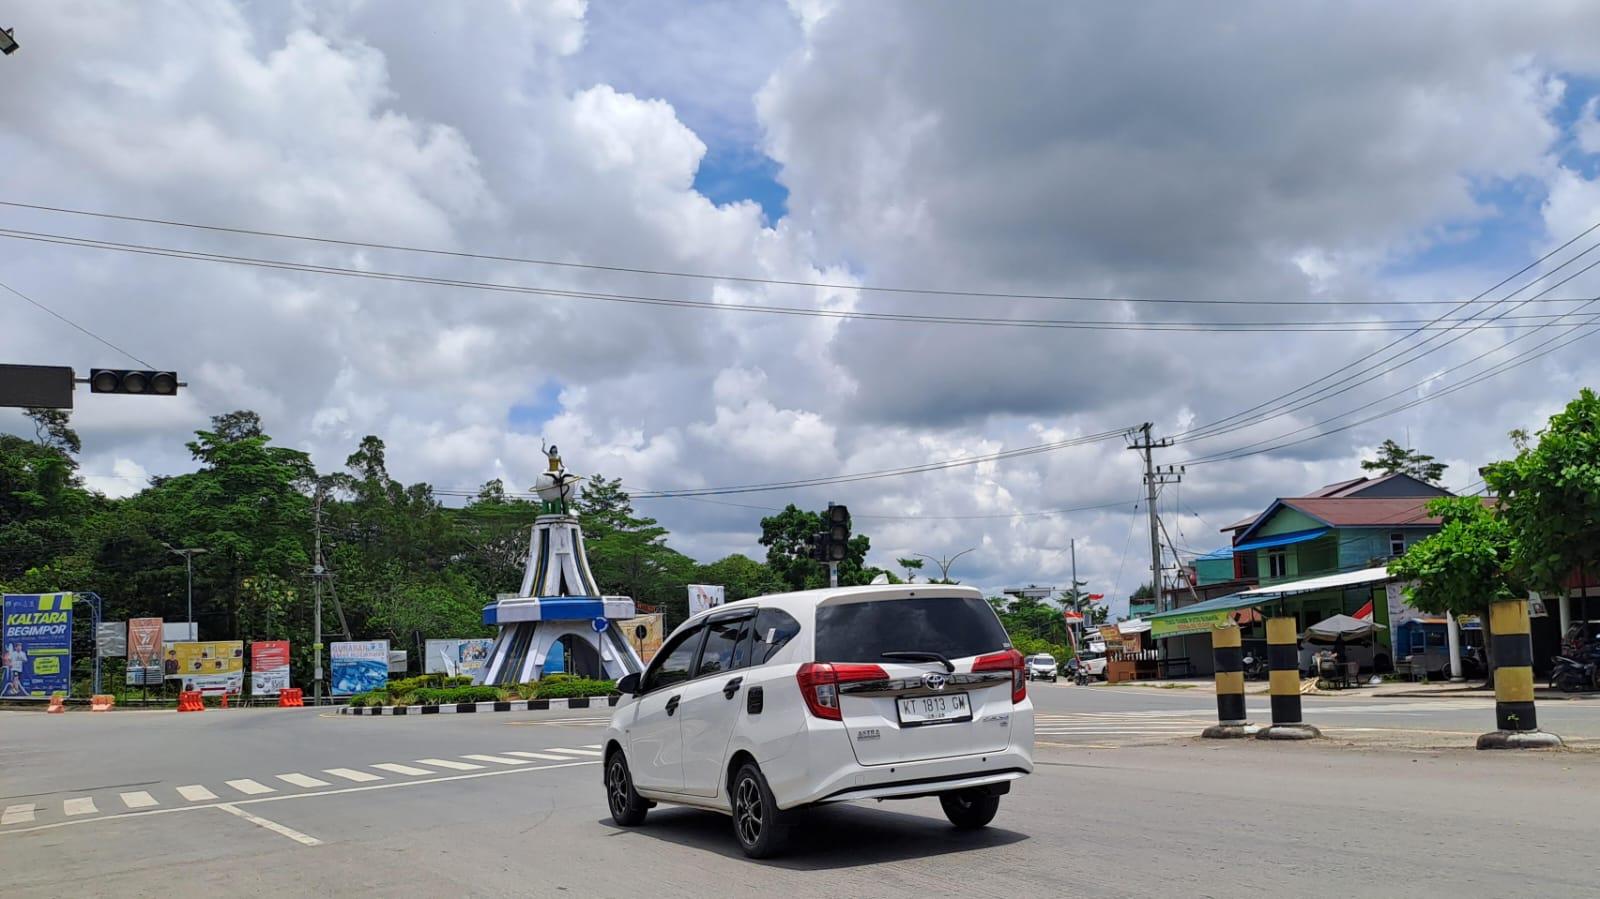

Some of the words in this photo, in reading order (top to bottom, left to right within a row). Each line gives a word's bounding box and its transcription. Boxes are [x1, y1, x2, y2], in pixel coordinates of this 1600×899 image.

[6, 612, 68, 626] KALTARA
[6, 624, 67, 637] BEGIMPOR
[904, 699, 916, 715] KT
[923, 697, 946, 713] 1813
